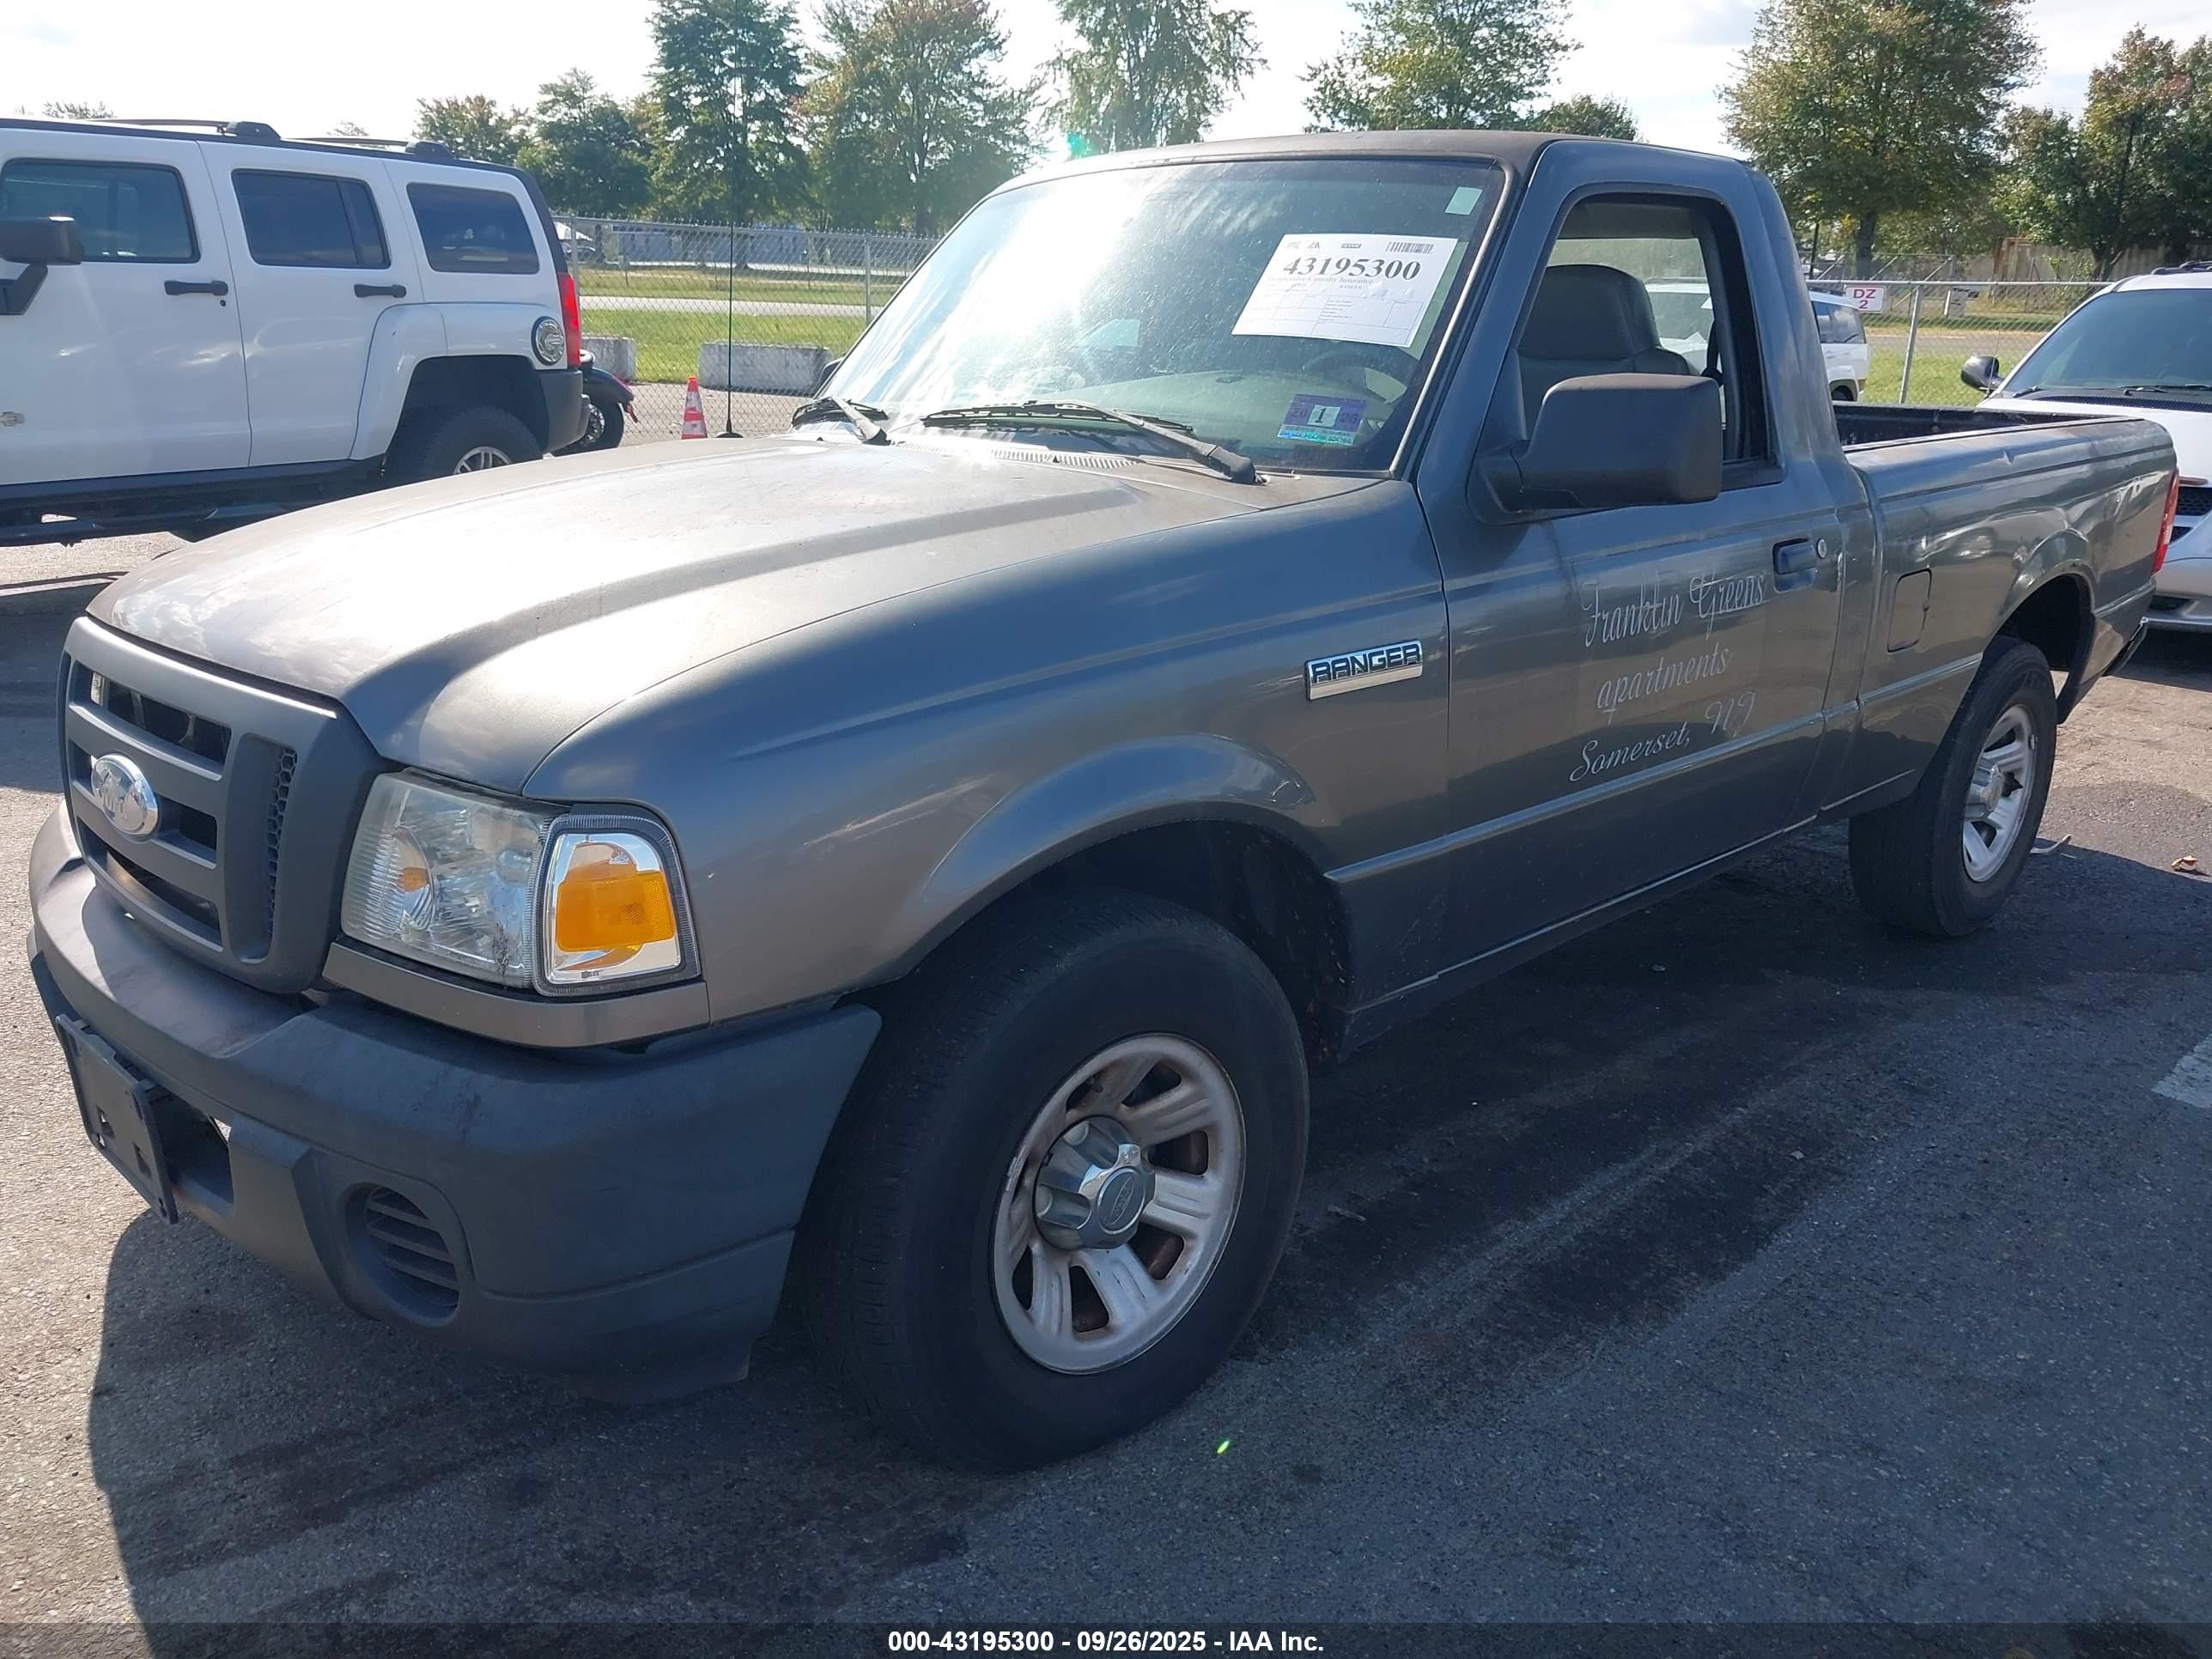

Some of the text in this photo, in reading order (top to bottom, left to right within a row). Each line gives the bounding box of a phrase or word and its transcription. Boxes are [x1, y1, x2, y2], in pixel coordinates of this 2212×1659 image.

[1282, 257, 1422, 281] 43195300
[1853, 289, 1877, 299] DZ
[1858, 299, 1869, 309] 2
[1315, 407, 1328, 423] 1
[1581, 571, 1683, 647] Franklin
[1310, 642, 1422, 685] RANGER
[1596, 642, 1730, 726] apartments
[1569, 690, 1757, 782] Somerset, NJ
